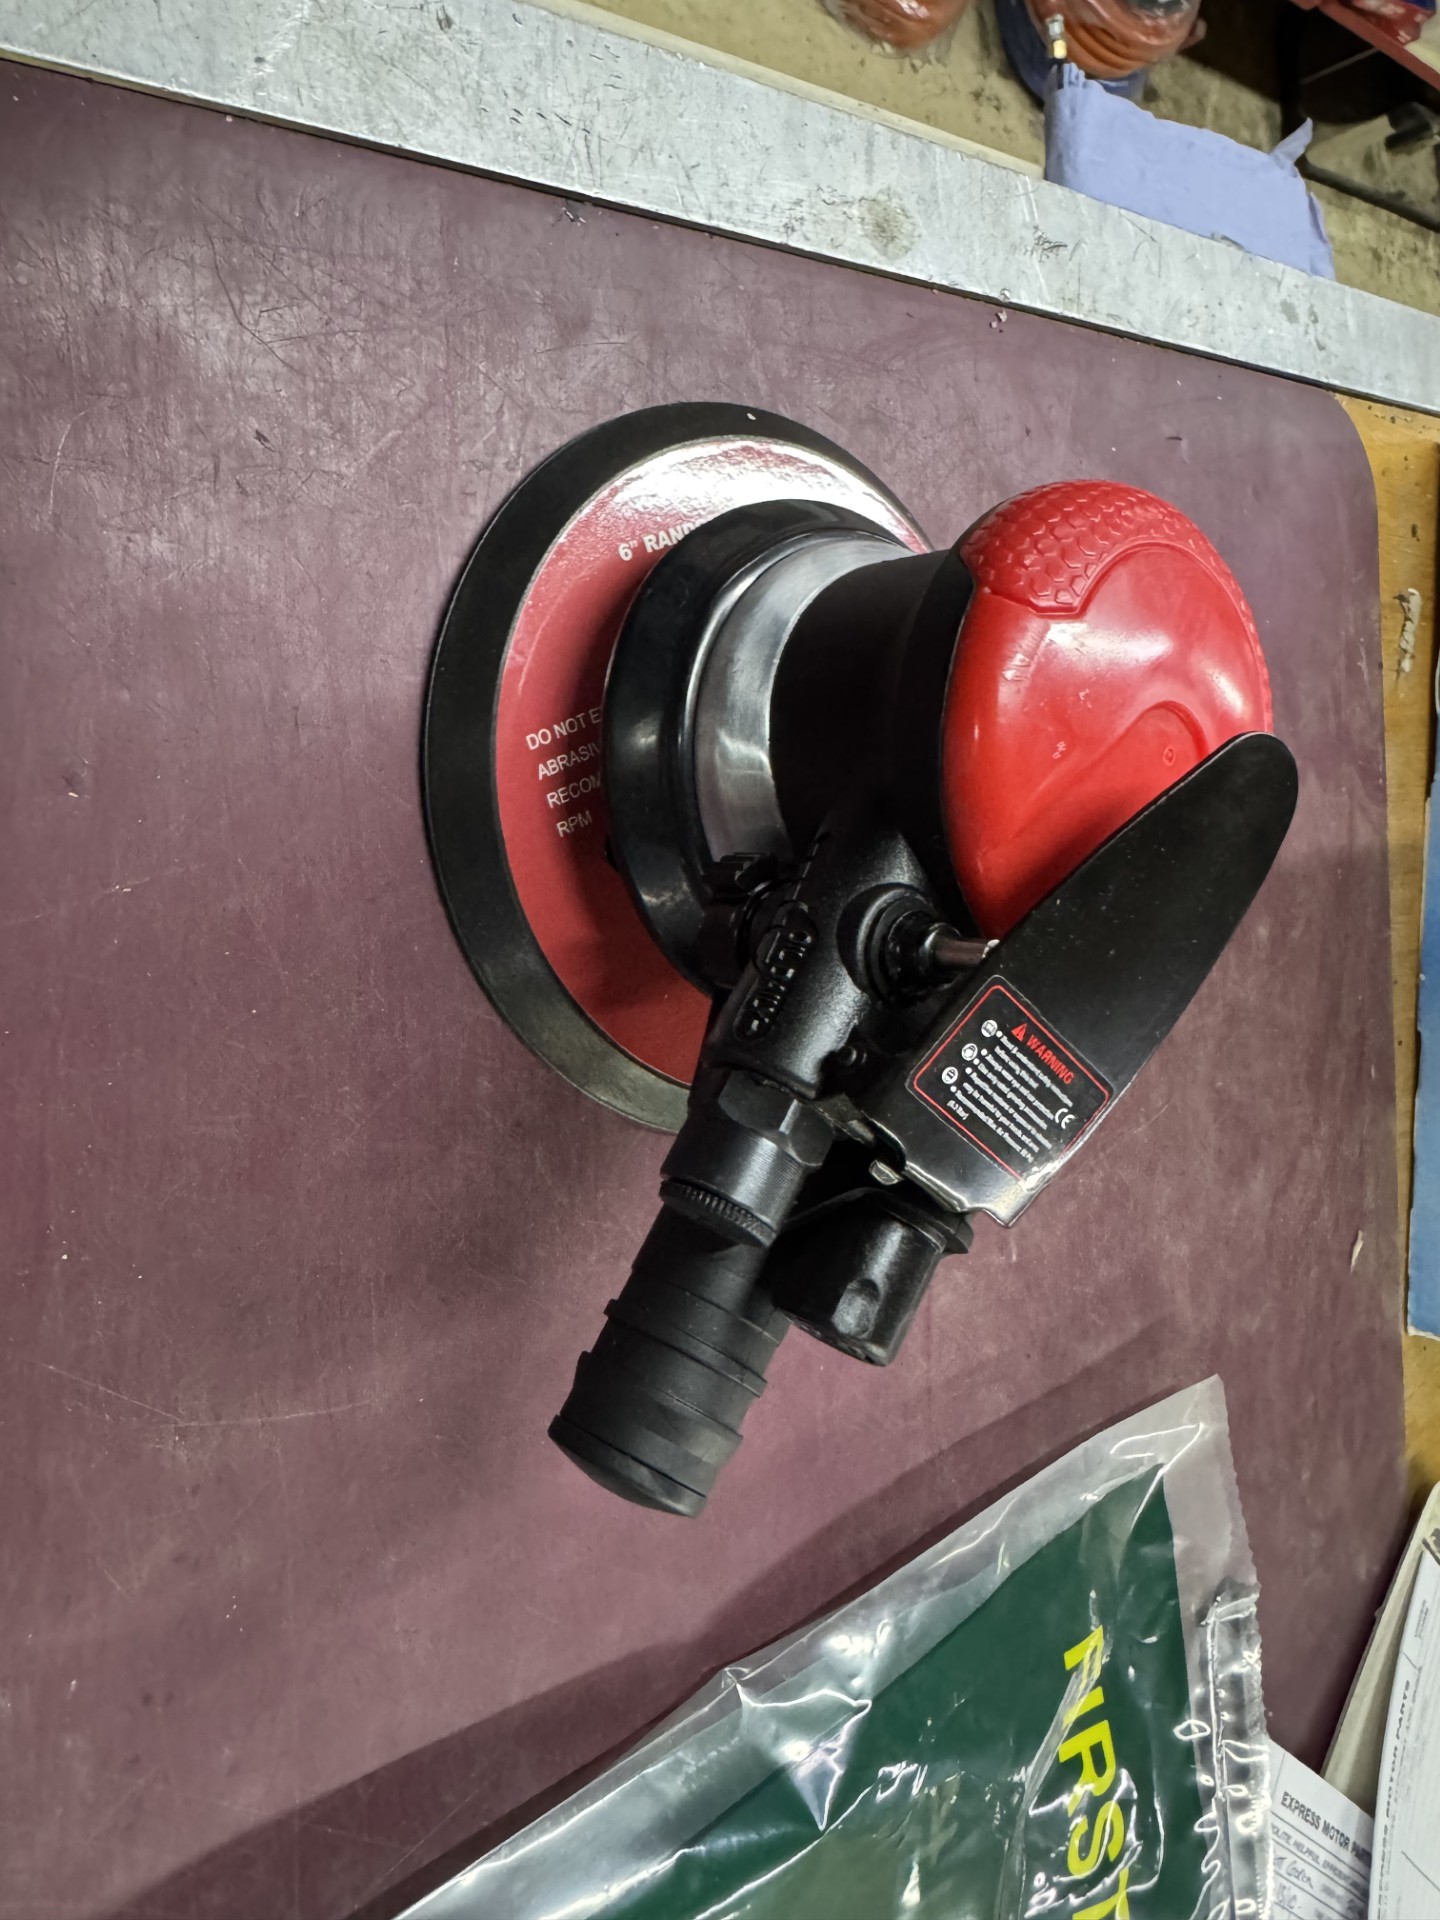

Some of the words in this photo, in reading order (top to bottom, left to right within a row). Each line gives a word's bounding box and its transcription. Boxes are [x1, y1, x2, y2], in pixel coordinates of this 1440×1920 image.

[617, 540, 638, 561] 6"
[525, 728, 551, 750] DO
[553, 712, 586, 738] NOT
[556, 810, 593, 837] RPM
[1026, 1033, 1075, 1085] WARNING
[1280, 1791, 1321, 1830] EXPRESS
[1321, 1820, 1351, 1851] MOTOR
